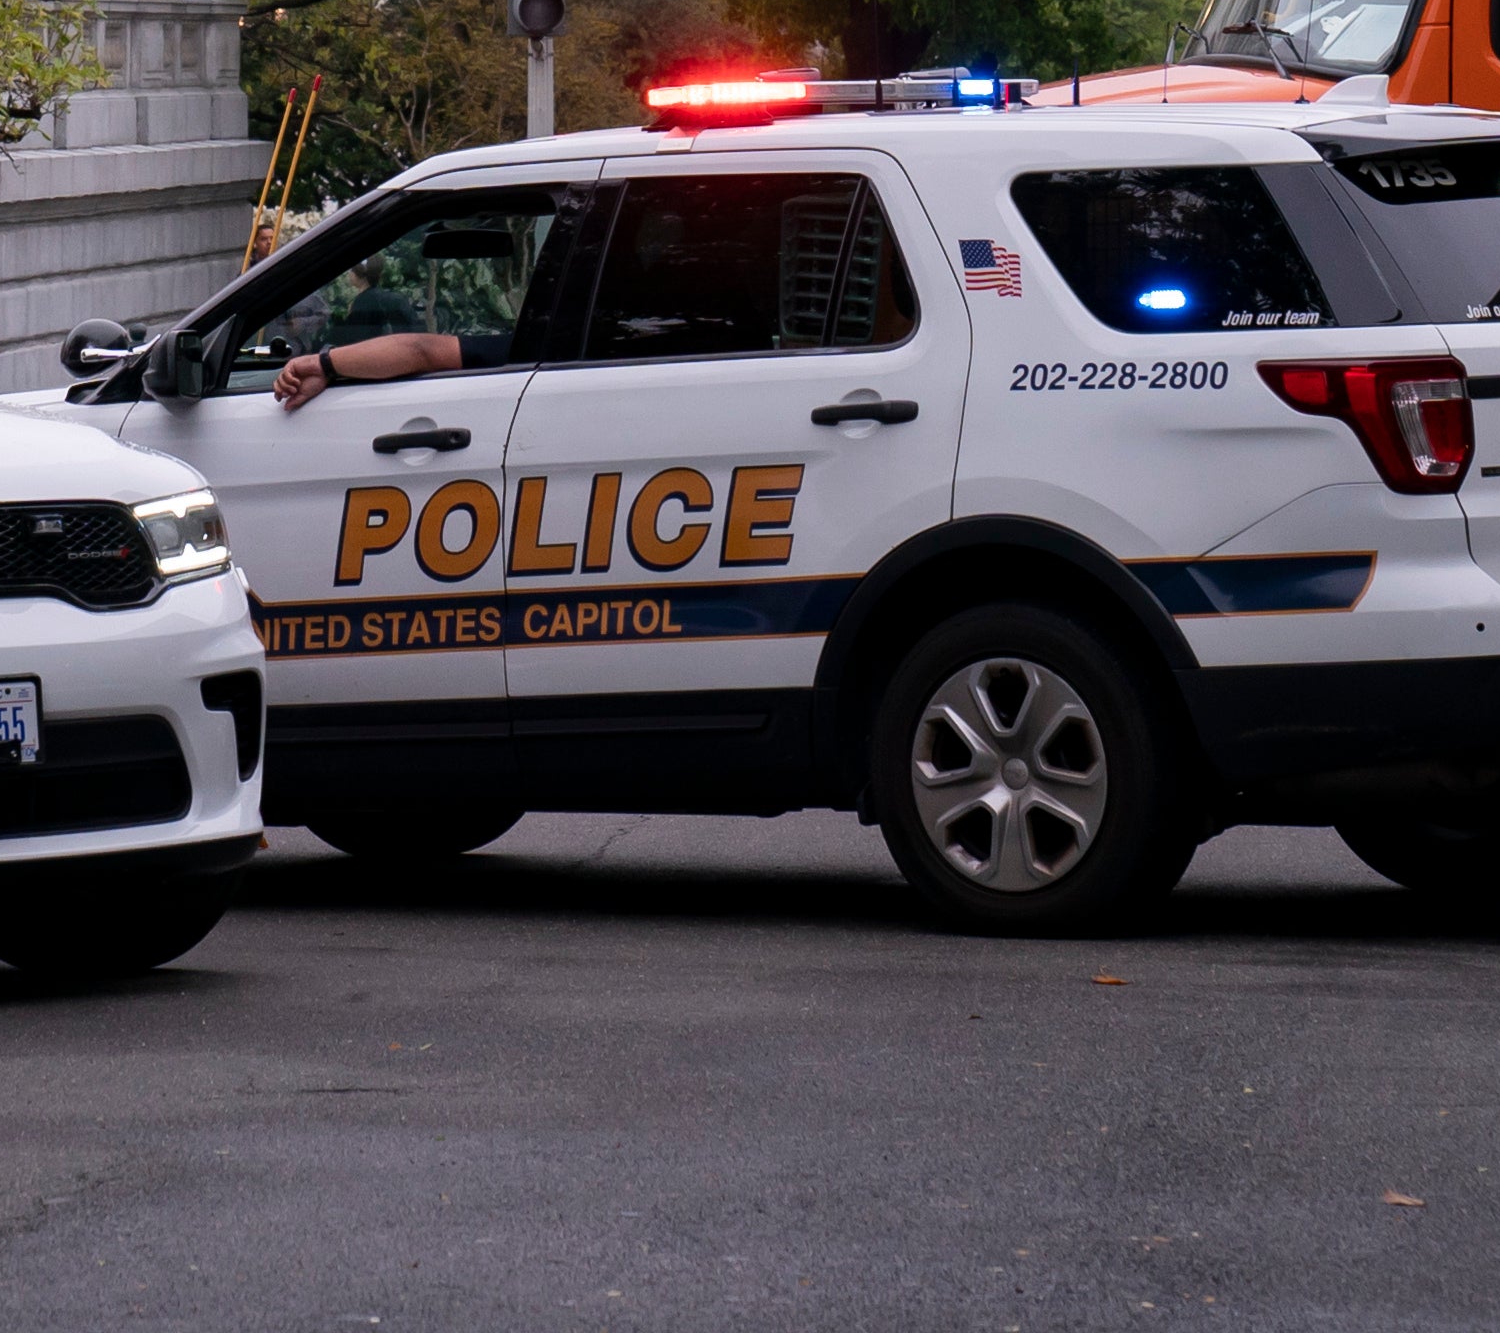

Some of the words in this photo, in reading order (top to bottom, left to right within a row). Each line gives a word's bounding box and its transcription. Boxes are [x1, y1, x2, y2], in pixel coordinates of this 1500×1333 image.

[1358, 158, 1457, 188] 1735
[1222, 310, 1253, 326] Join
[1256, 312, 1282, 325] our
[1284, 310, 1320, 325] team
[1466, 304, 1491, 319] Join
[1010, 360, 1229, 391] 202-228-2800
[333, 463, 805, 587] POLICE
[253, 615, 352, 652] NITED
[361, 606, 501, 649] STATES
[523, 598, 683, 640] CAPITOL
